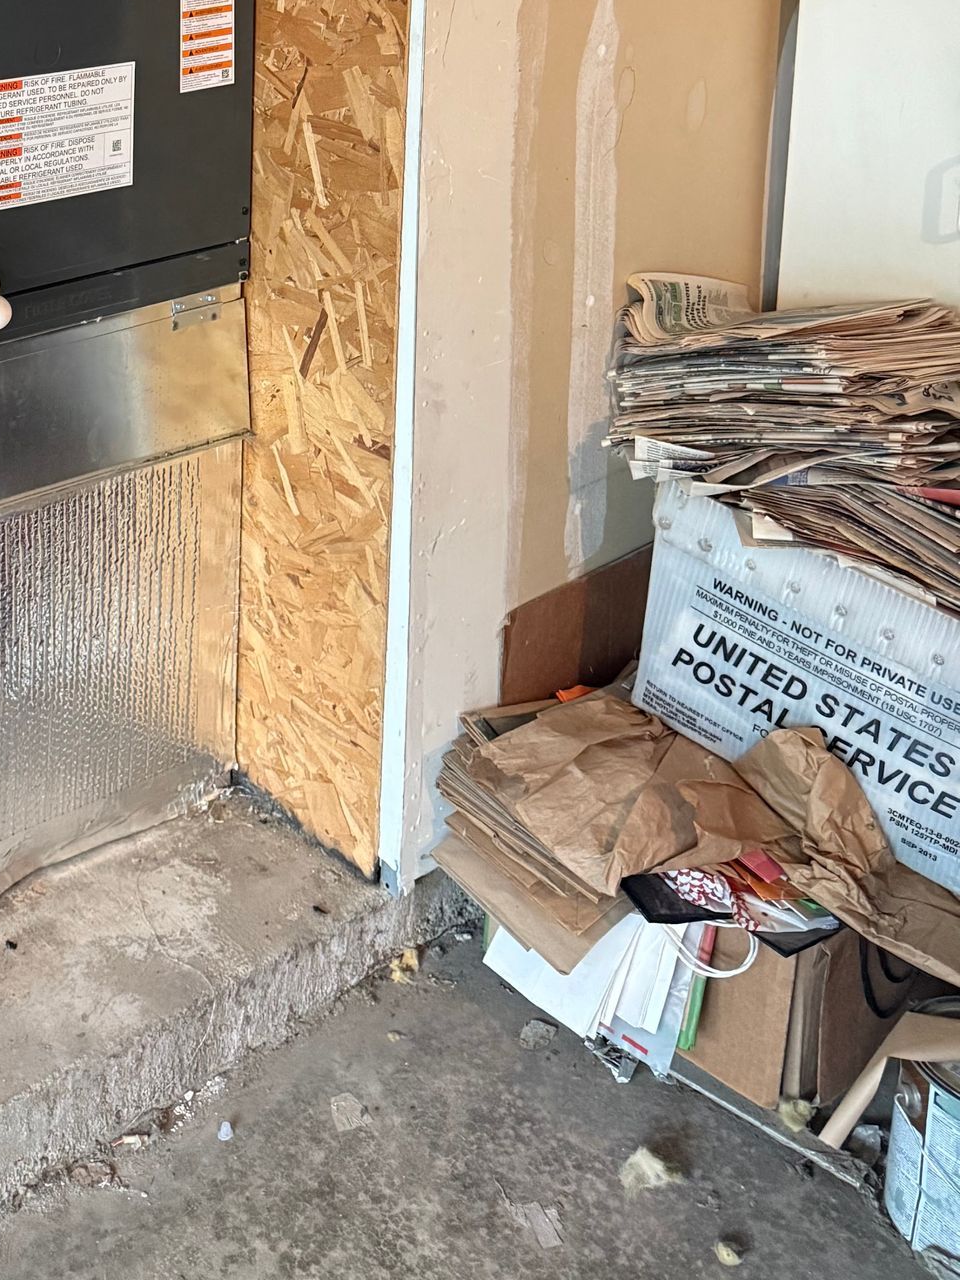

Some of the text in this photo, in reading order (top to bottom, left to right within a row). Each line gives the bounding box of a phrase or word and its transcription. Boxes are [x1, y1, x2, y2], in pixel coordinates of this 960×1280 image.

[24, 79, 39, 87] RISK
[40, 78, 50, 86] OF
[69, 70, 105, 81] FLAMMABLE
[69, 81, 99, 91] REPAIRED
[101, 77, 118, 86] ONLY
[9, 98, 38, 108] SERVICE
[80, 90, 90, 98] DO
[91, 87, 104, 95] NOT
[16, 102, 62, 114] REFRIGERANT
[24, 146, 39, 154] RISK
[40, 144, 50, 152] OF
[69, 136, 95, 147] DISPOSE
[32, 149, 76, 163] ACCORDANCE
[78, 145, 94, 154] WITH
[19, 170, 64, 182] REFRIGERANT
[21, 163, 42, 173] LOCAL
[696, 589, 734, 617] MAXIMUM
[734, 609, 771, 634] PENALTY
[771, 630, 789, 647] FOR
[791, 638, 819, 661] THEFT
[819, 654, 834, 668] OR
[834, 660, 870, 687] MISUSE
[871, 681, 883, 695] OF
[883, 687, 919, 714] POSTAL
[713, 577, 779, 621] WARNING
[790, 620, 824, 644] NOT
[824, 637, 857, 664] FOR
[860, 656, 925, 699] PRIVATE
[930, 691, 960, 716] USE
[712, 610, 942, 737] $1,000 FINE AND 3 YEARS IMPRISONMENT (18 USC 1707)
[671, 647, 794, 730] POSTAL
[669, 694, 676, 703] TO
[677, 700, 704, 719] NEAREST
[693, 623, 956, 778] UNITED STATES
[889, 817, 908, 831] PSIN
[919, 848, 937, 861] 2013
